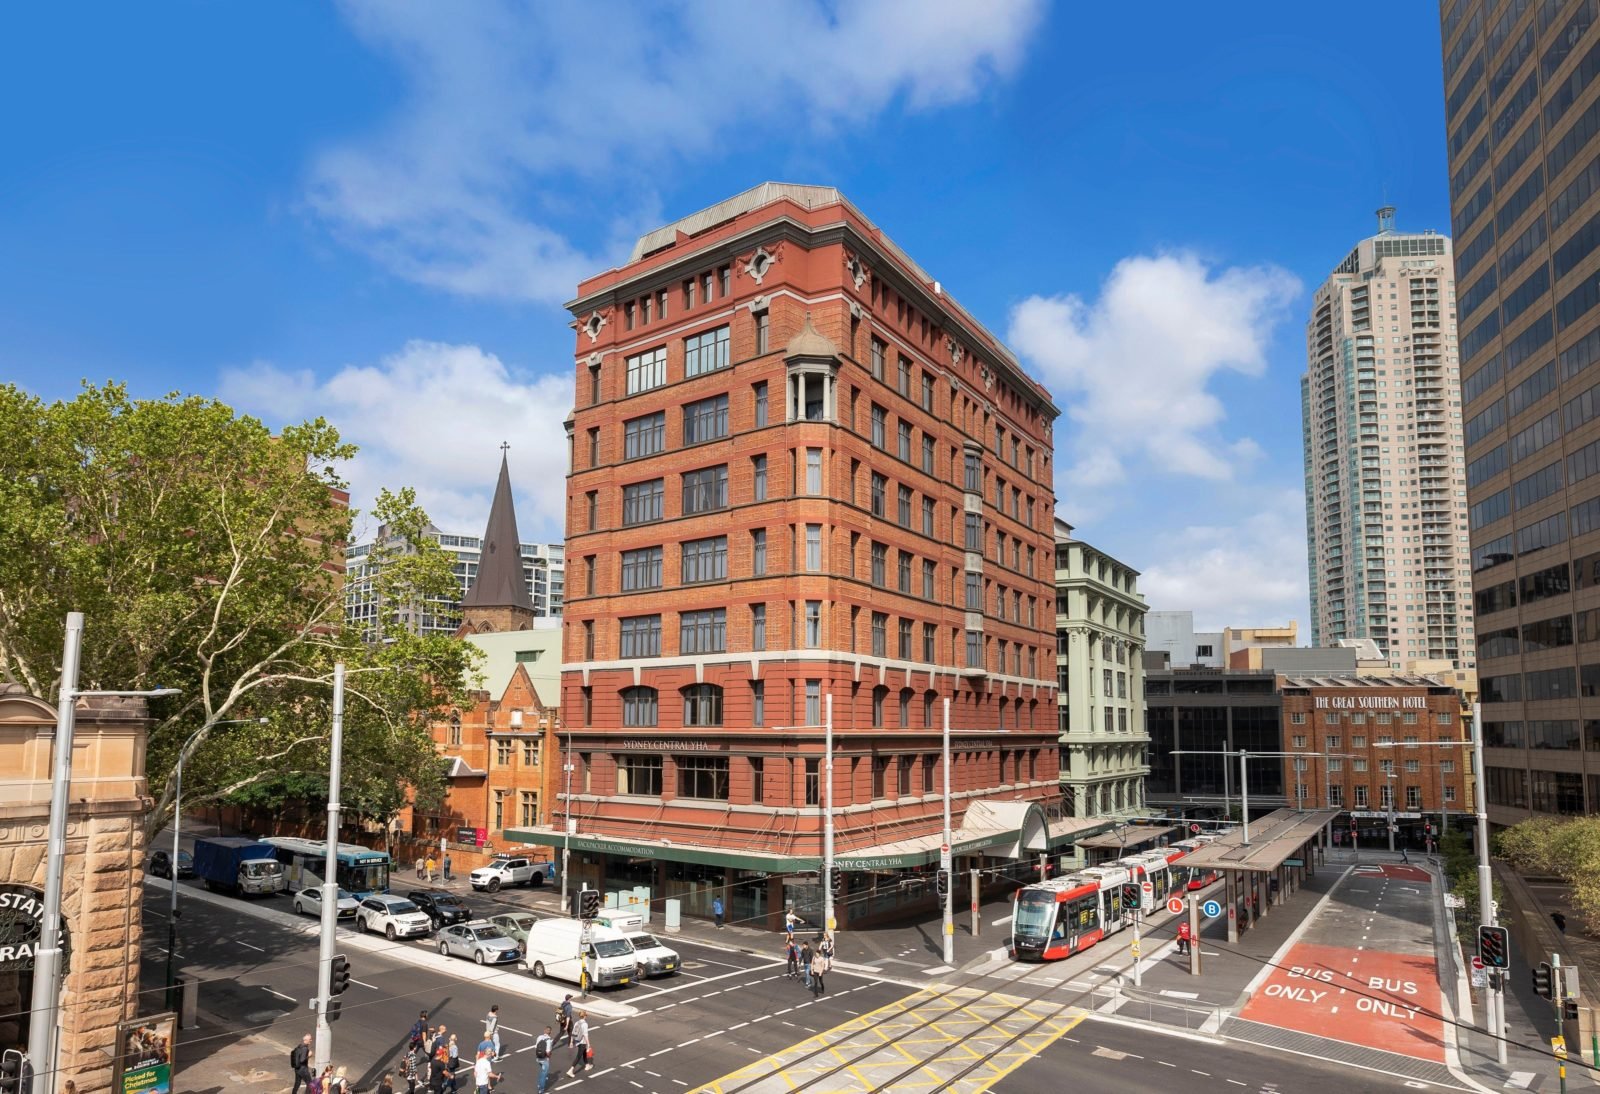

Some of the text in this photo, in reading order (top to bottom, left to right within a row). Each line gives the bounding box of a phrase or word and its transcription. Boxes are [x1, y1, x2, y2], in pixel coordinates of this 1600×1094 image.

[1315, 696, 1428, 709] THE GREAT SOUTHERN HOTEL
[623, 740, 708, 750] SYDNEY CENTRAL YHA
[607, 844, 655, 855] ACCOMMODATION
[833, 860, 854, 868] DNEY
[855, 859, 887, 868] CENTRAL
[1287, 966, 1335, 982] BUS
[1368, 976, 1418, 994] BUS
[1264, 984, 1328, 1004] ONLY
[1356, 998, 1421, 1020] ONLY
[124, 1076, 158, 1090] Christmas
[125, 1070, 156, 1083] Picked for
